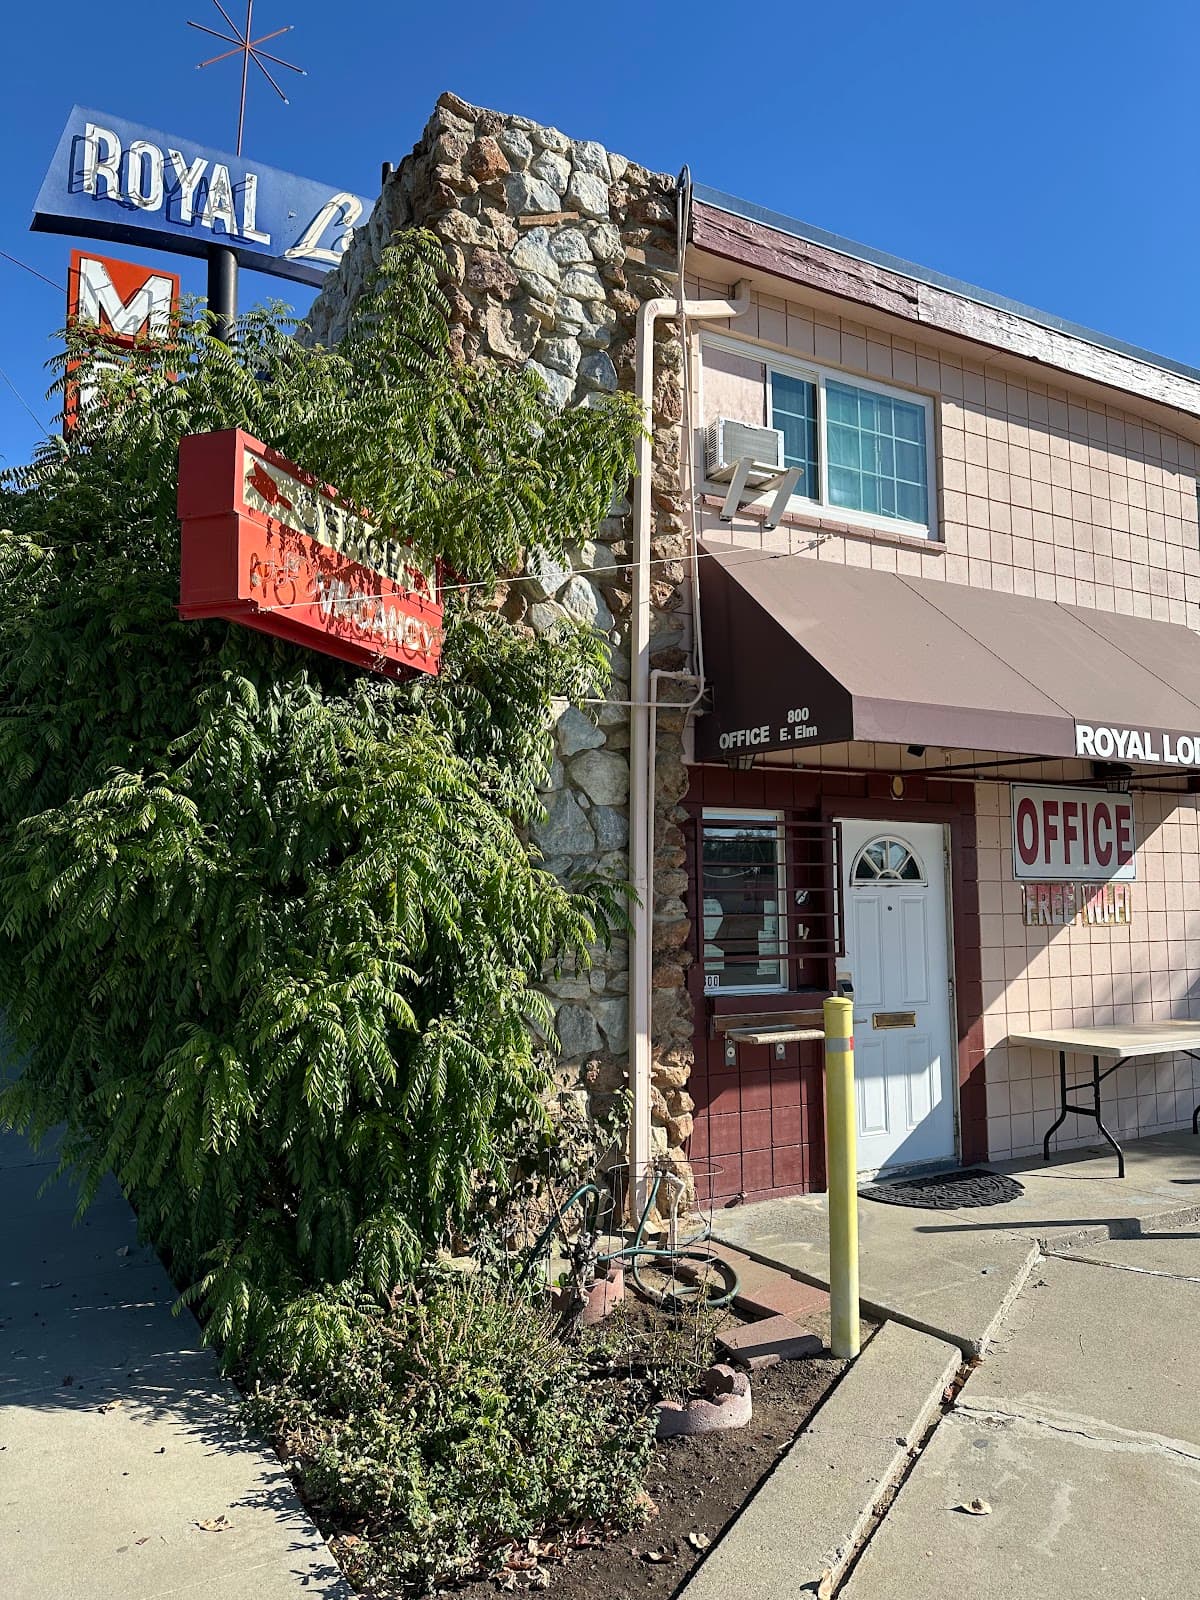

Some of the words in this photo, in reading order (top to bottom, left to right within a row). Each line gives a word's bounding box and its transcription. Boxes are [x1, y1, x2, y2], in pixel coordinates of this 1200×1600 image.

[83, 122, 271, 246] ROYAL
[779, 727, 792, 741] E.
[795, 724, 818, 740] Elm
[787, 707, 810, 724] 800
[719, 725, 770, 750] OFFICE
[1075, 724, 1160, 762] ROYAL
[1016, 797, 1133, 867] OFFICE
[1025, 884, 1076, 925] FREE
